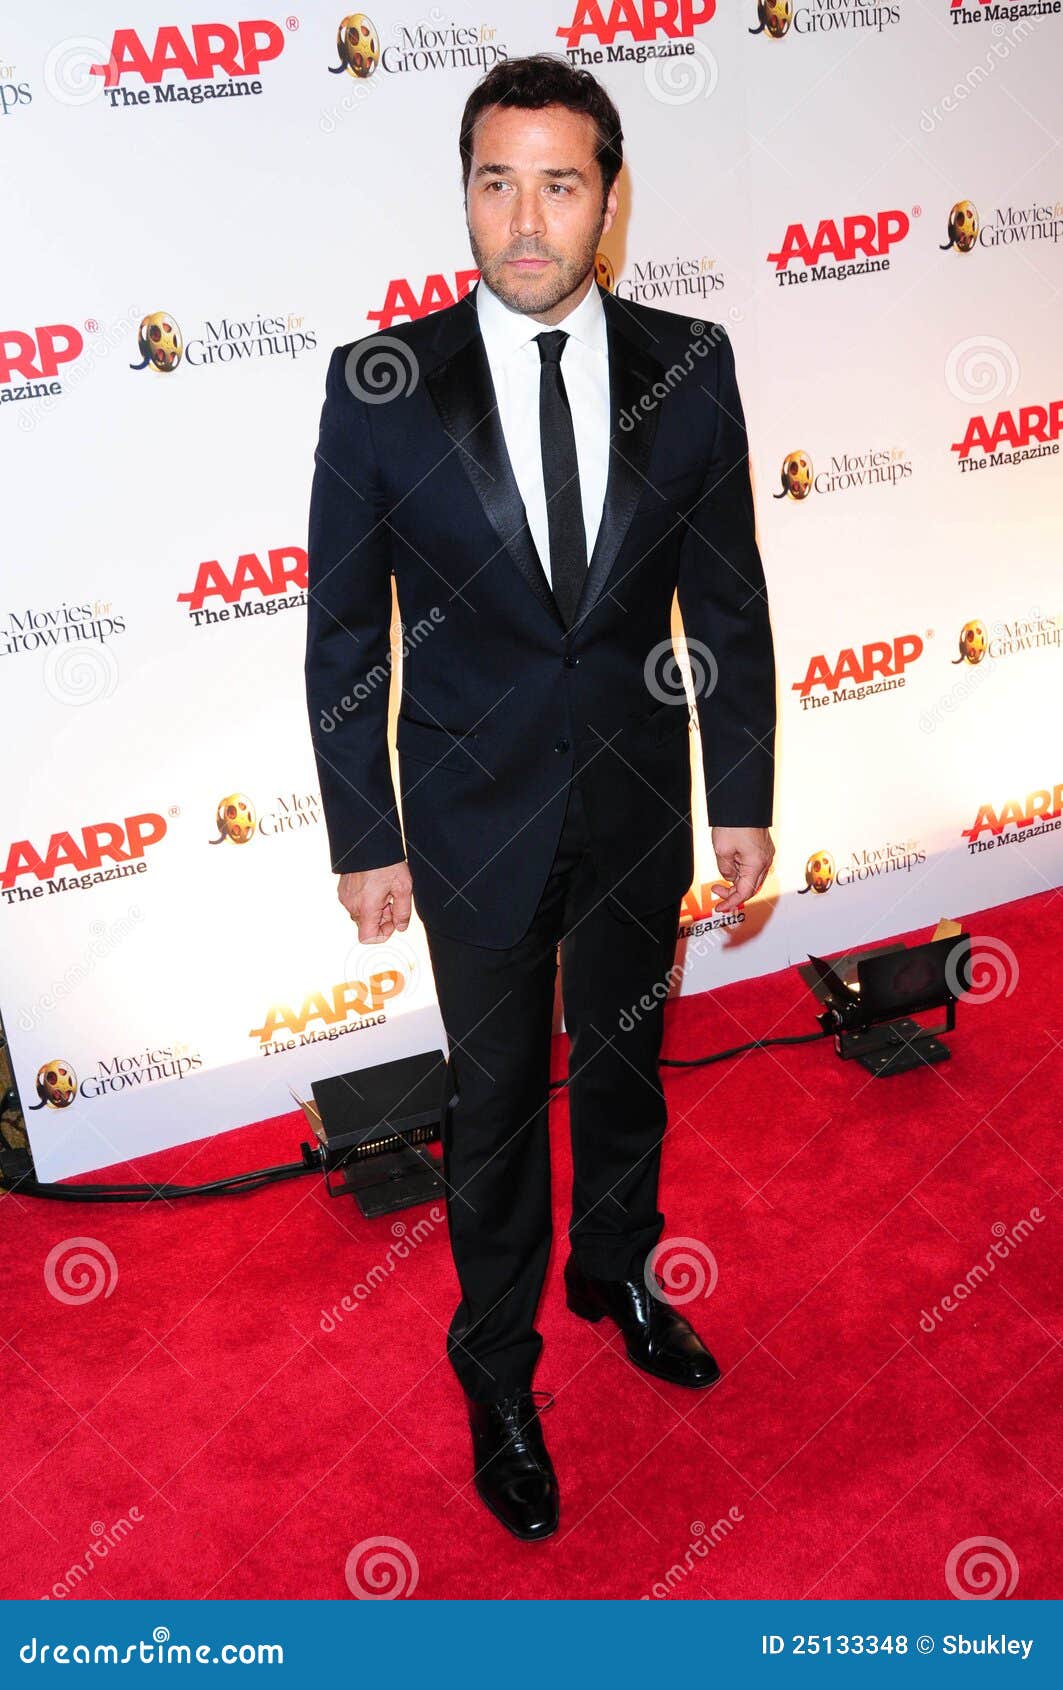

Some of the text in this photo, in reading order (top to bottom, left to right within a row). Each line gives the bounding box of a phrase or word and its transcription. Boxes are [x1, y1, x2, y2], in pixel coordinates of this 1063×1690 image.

[793, 5, 900, 33] Grownups
[950, 8, 981, 25] The
[984, 0, 1061, 21] Magazine
[401, 22, 497, 49] Movies for
[89, 20, 285, 87] AARP
[381, 43, 508, 73] Grownups
[566, 41, 695, 66] The Magazine
[105, 79, 263, 108] The Magazine
[996, 203, 1052, 228] Movies
[766, 209, 910, 271] AARP
[634, 256, 700, 283] Movies
[775, 257, 890, 287] The Magazine
[615, 272, 725, 301] Grownups
[204, 313, 285, 343] Movies
[185, 330, 317, 366] Grownups
[0, 382, 63, 405] azine
[830, 449, 890, 476] Movies
[957, 443, 1060, 474] The Magazine
[814, 460, 912, 494] Grownups
[9, 602, 93, 633] Movies
[189, 609, 230, 627] The
[1004, 615, 1056, 638] Movies
[791, 634, 924, 697] AARP
[799, 677, 906, 711] The Magazine
[0, 812, 168, 889] AARP
[967, 820, 1062, 855] The Magazine
[835, 849, 927, 886] Grownups
[851, 842, 905, 866] Movies
[2, 861, 148, 905] The Magazine
[249, 970, 406, 1043] AARP
[260, 1014, 387, 1057] The Magazine
[79, 1054, 203, 1099] Grownups
[98, 1048, 173, 1078] Movies
